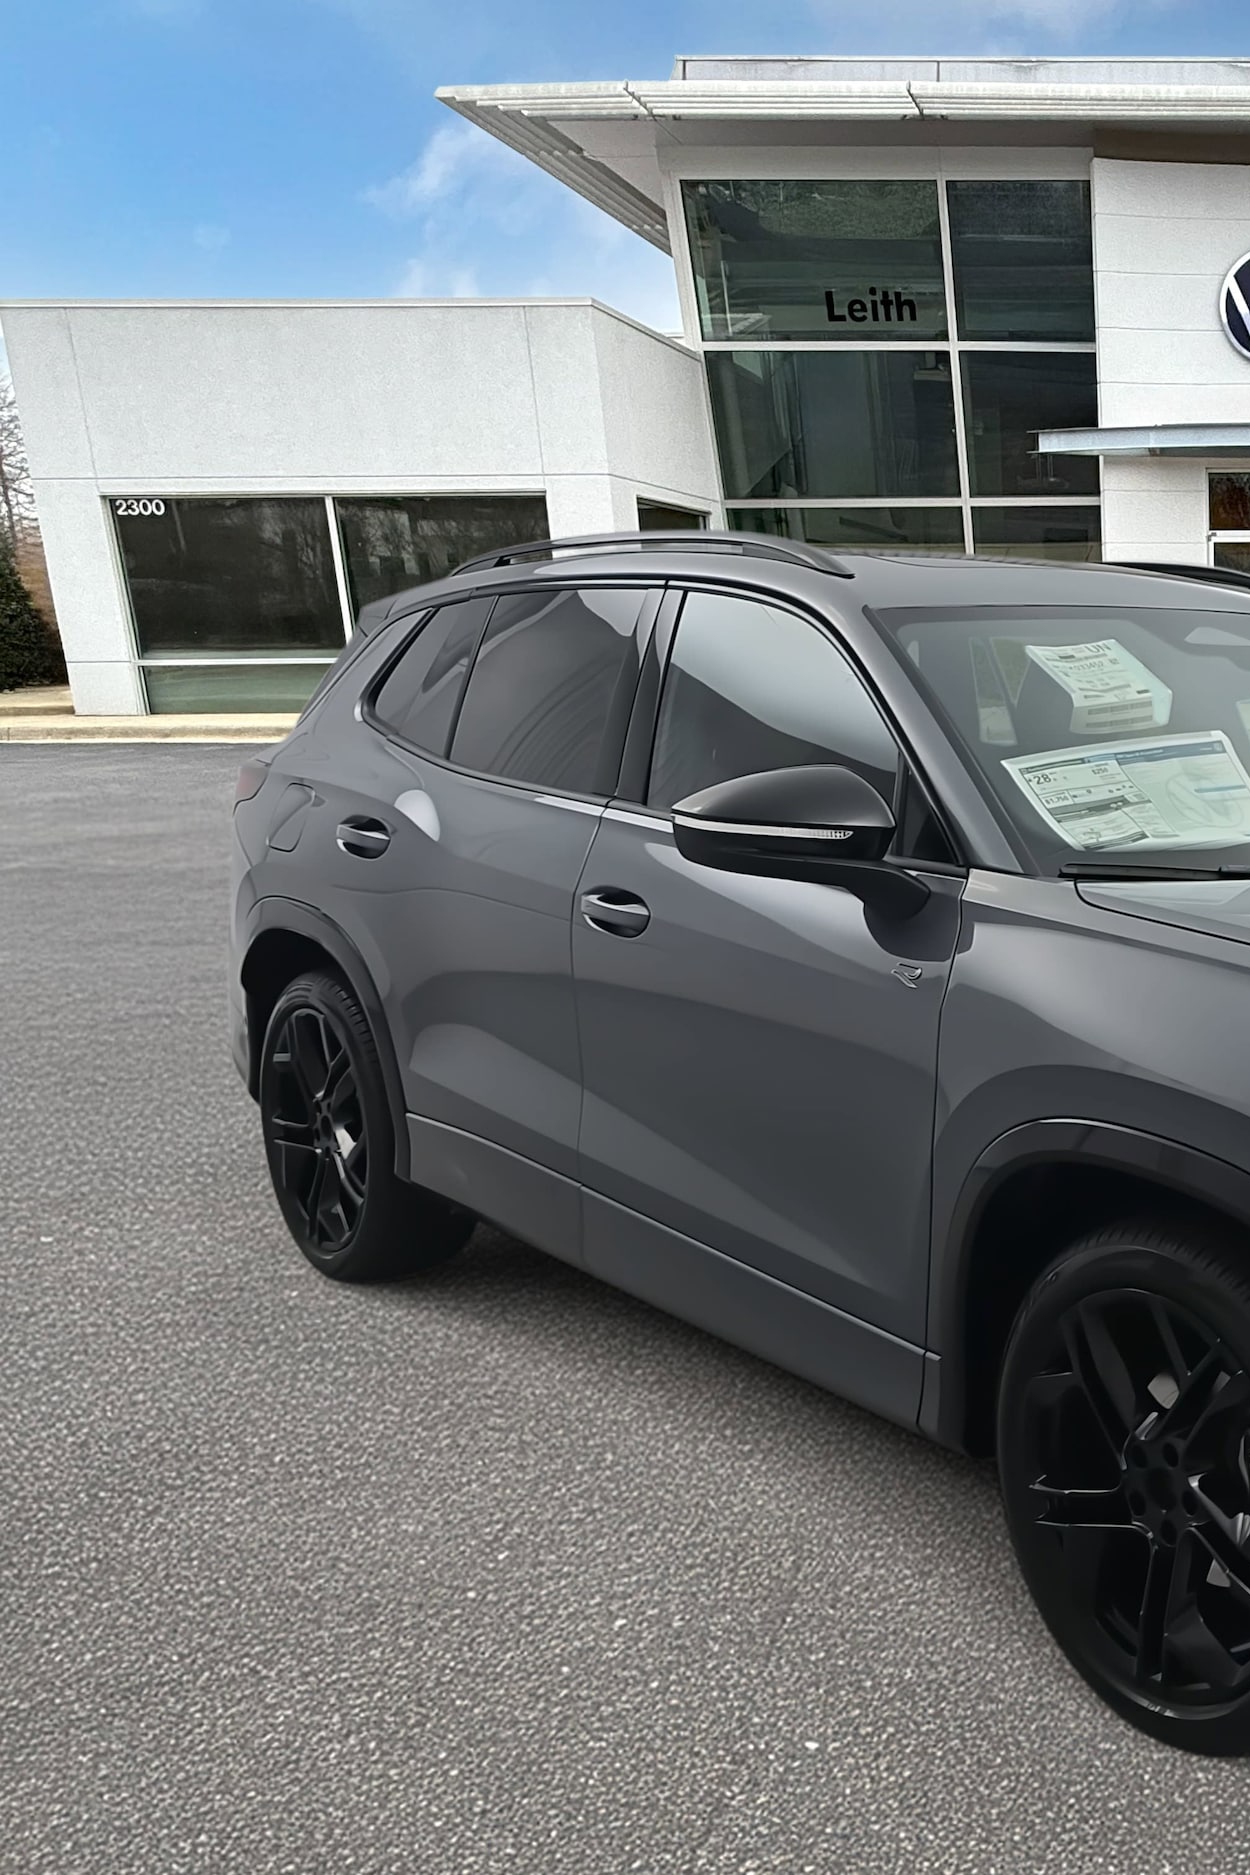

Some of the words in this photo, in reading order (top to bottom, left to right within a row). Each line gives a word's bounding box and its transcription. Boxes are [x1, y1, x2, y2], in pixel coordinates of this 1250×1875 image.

[825, 287, 917, 322] Leith
[115, 499, 165, 516] 2300
[1033, 773, 1052, 785] 28
